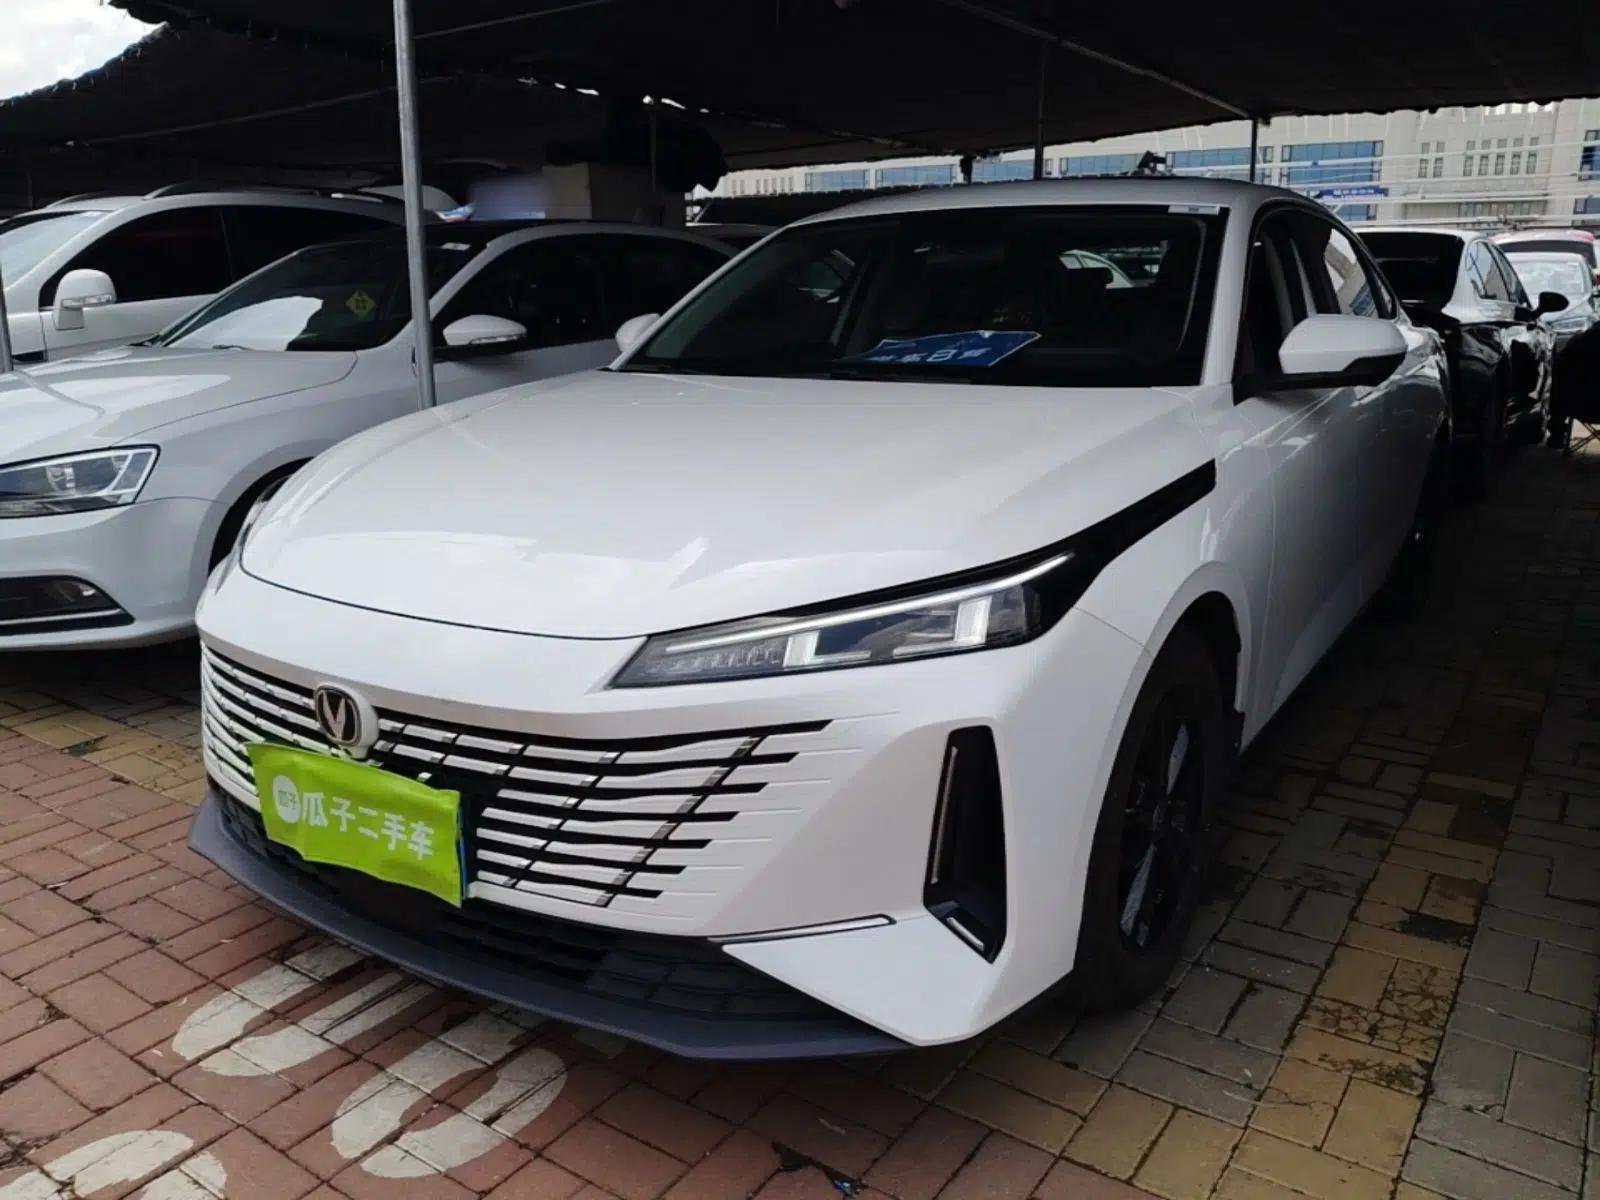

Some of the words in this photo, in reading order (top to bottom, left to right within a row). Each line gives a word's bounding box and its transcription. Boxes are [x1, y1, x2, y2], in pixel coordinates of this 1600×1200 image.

[303, 792, 434, 861] 瓜子二手车
